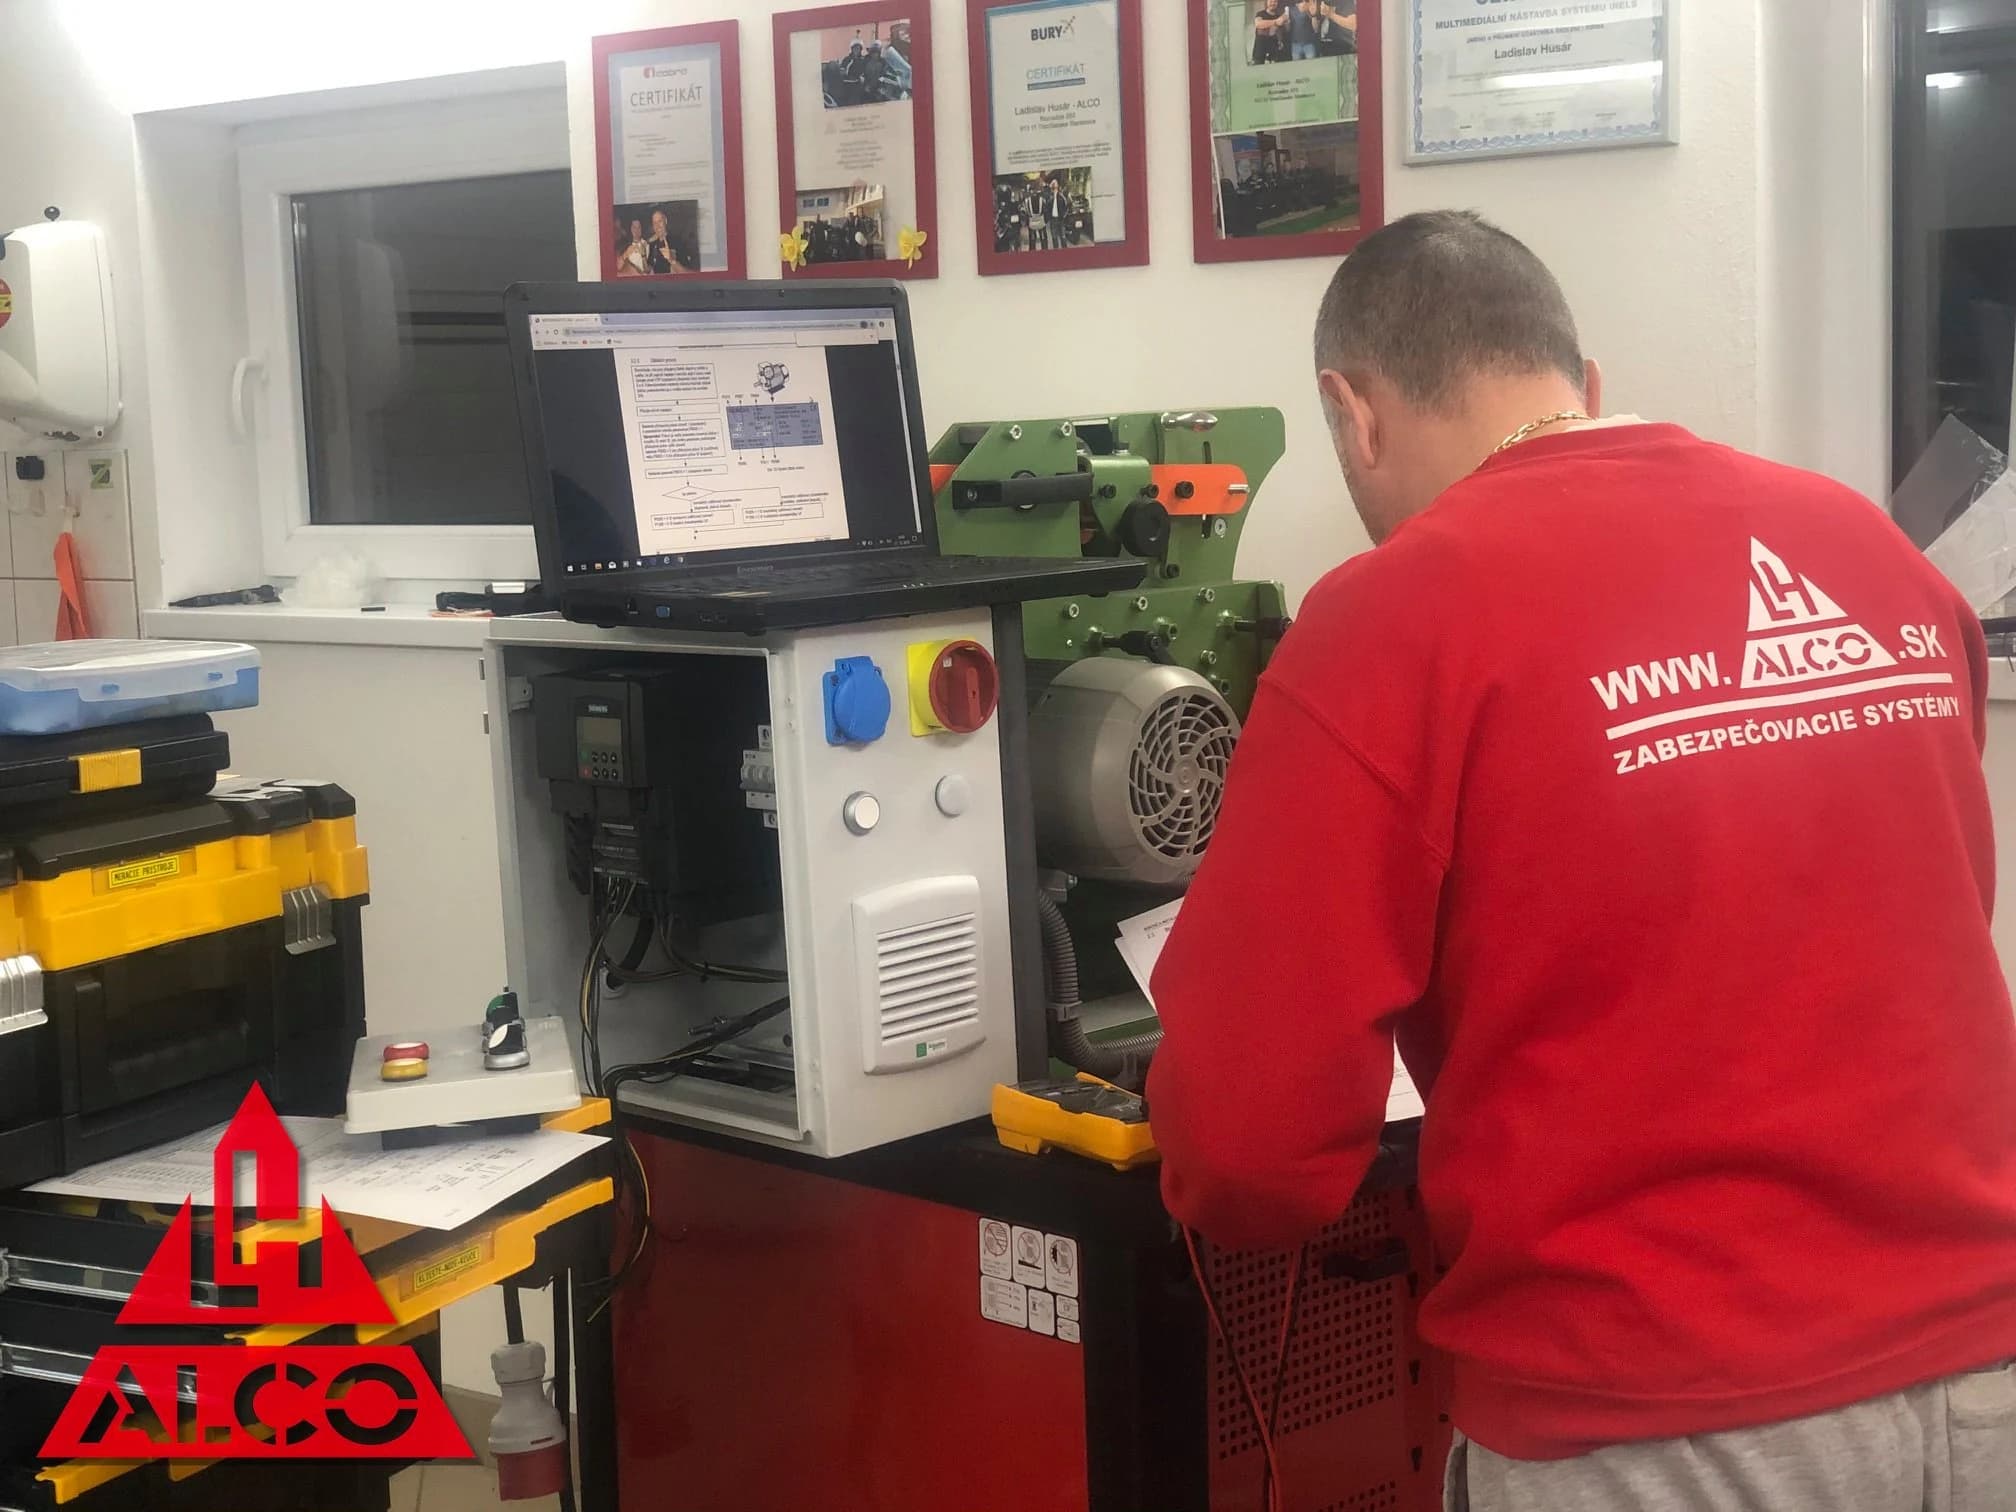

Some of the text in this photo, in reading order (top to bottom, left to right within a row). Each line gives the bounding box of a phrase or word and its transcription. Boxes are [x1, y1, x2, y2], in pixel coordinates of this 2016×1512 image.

[1031, 25, 1063, 41] BURY
[1494, 41, 1573, 60] Ladislav Husár
[1026, 62, 1086, 80] CERTIFIKÁT
[630, 82, 703, 107] CERTIFIKÁT
[1014, 104, 1045, 116] Ladislav
[1047, 101, 1070, 112] Husár
[1077, 97, 1101, 109] ALCO
[1589, 624, 1948, 711] WWW. ALCO .SK
[1613, 691, 1961, 775] ZABEZPEČOVACIE SYSTÉMY
